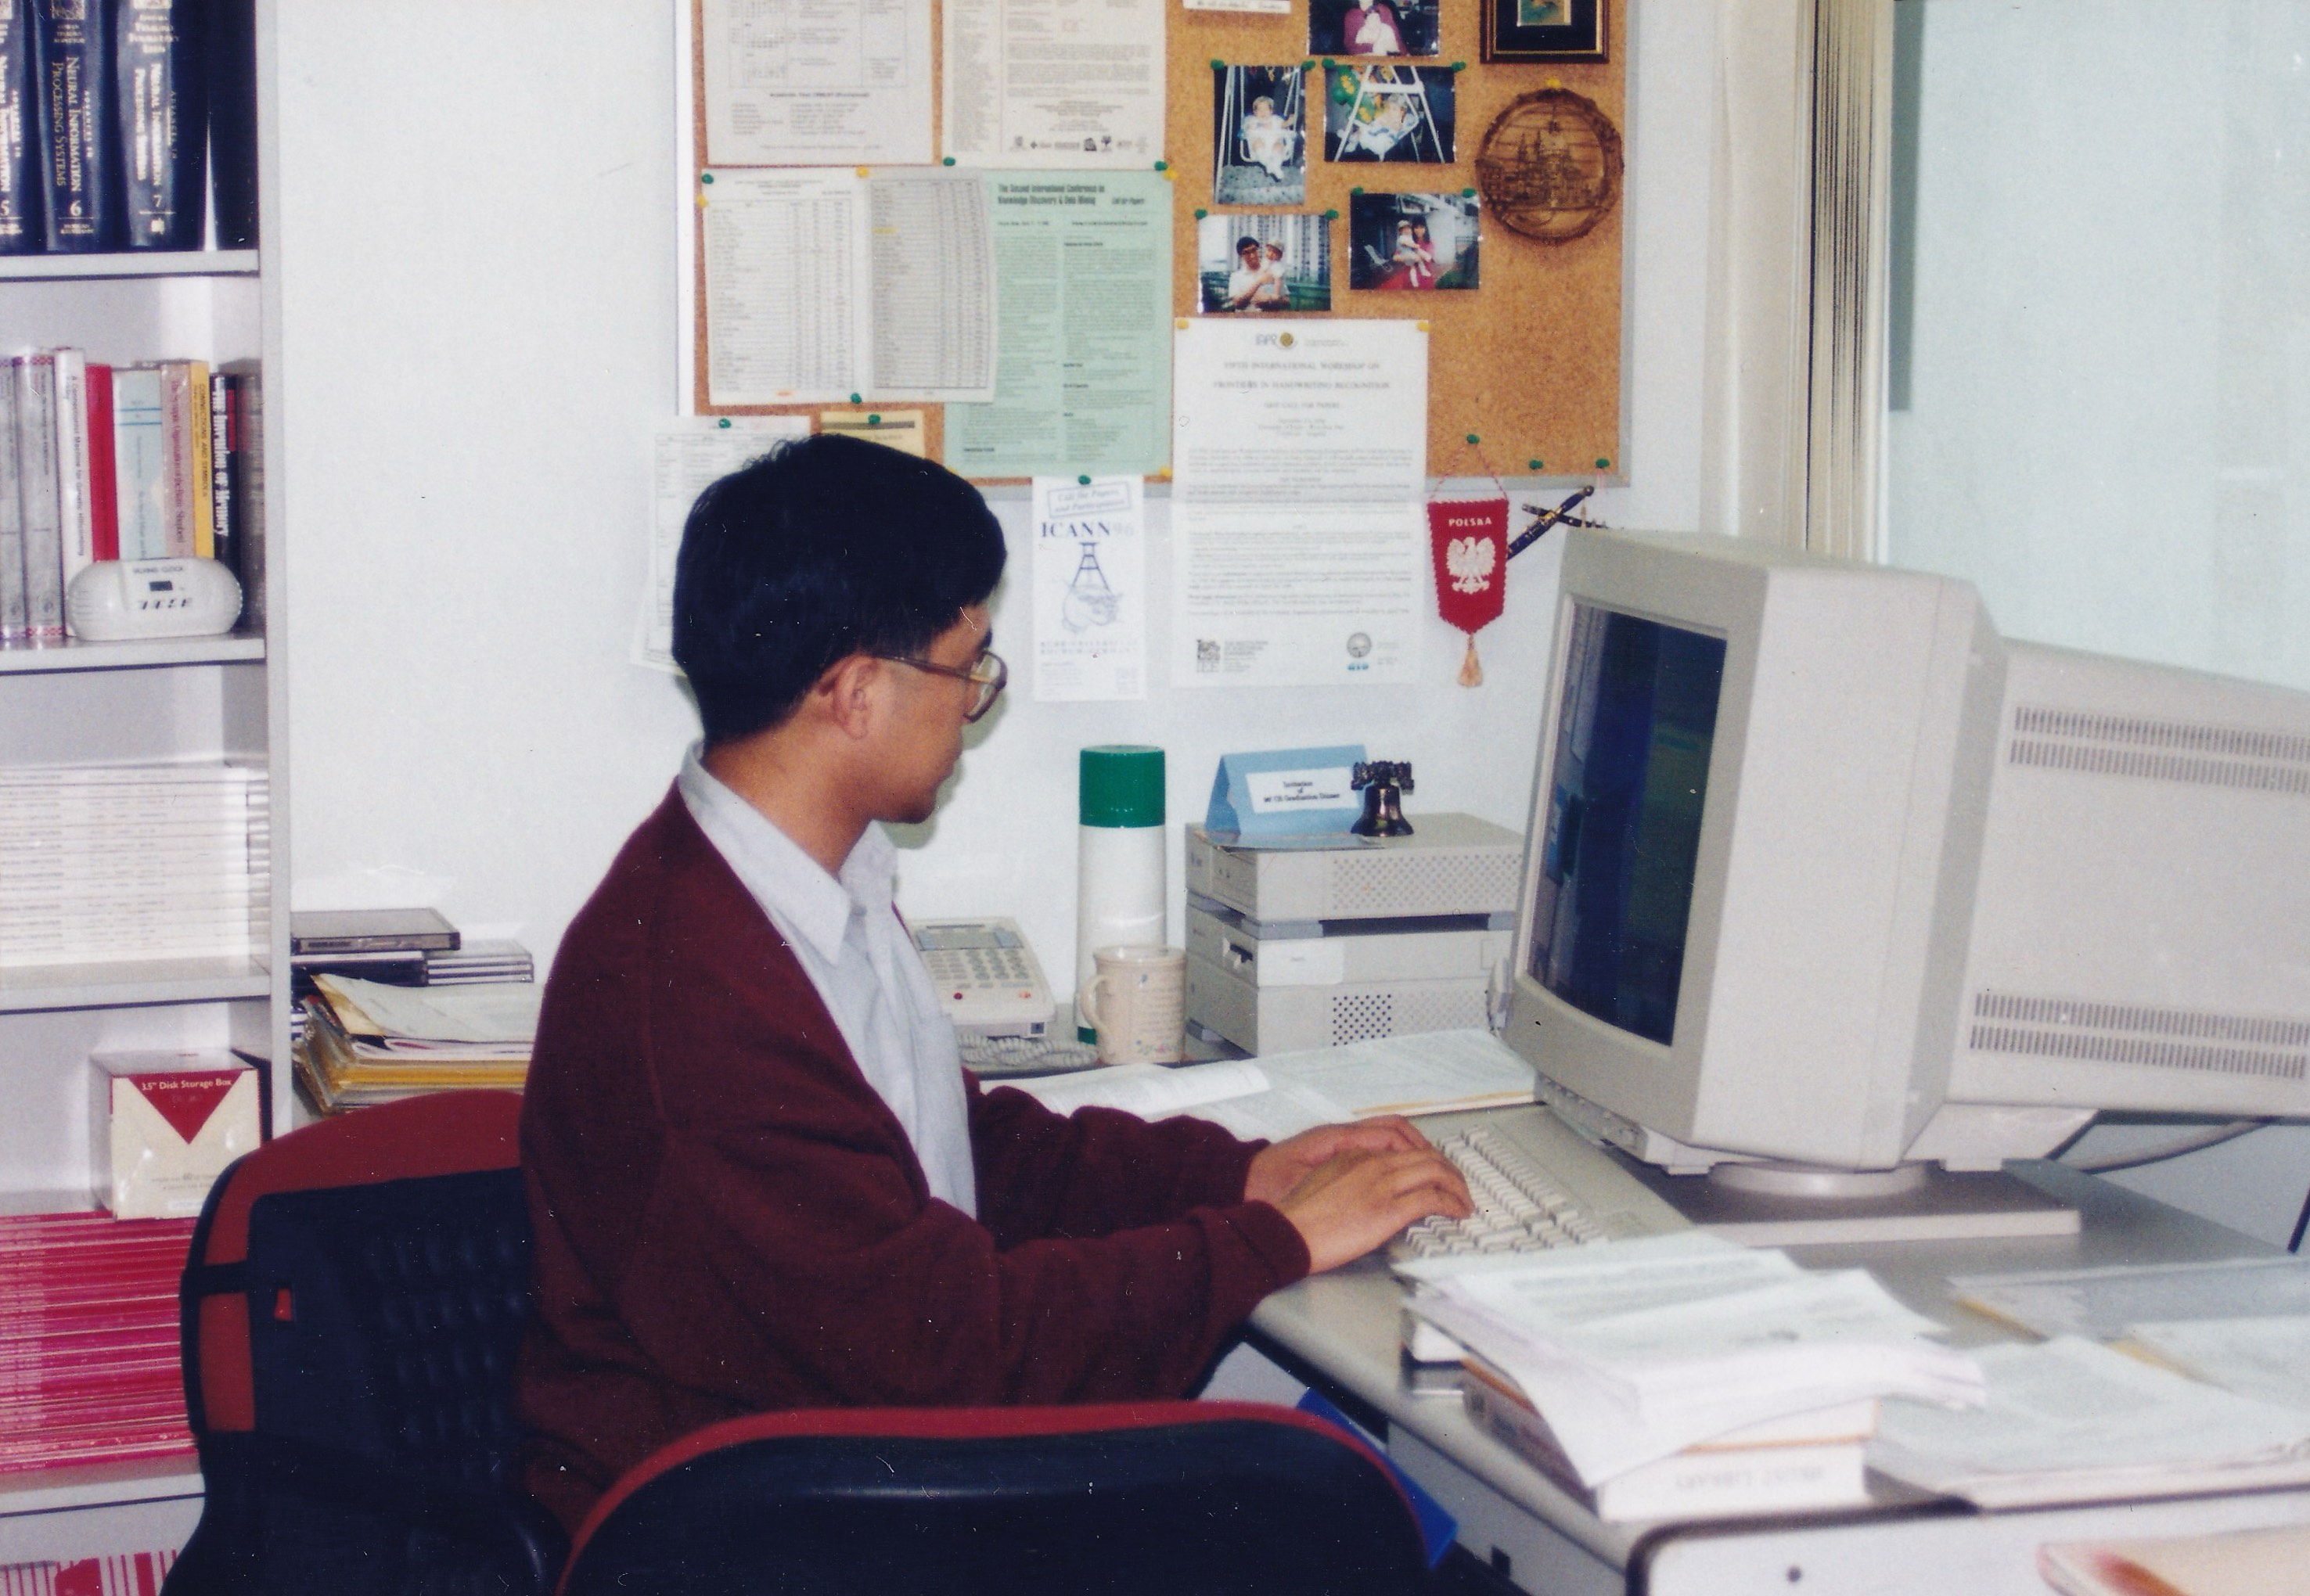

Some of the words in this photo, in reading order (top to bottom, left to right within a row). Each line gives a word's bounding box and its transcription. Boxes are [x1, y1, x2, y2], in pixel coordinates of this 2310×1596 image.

[66, 56, 80, 106] NEURAL
[52, 62, 64, 134] PROCESSING
[68, 109, 82, 192] INFORMATION
[55, 135, 67, 187] SYSTEMS
[0, 200, 10, 216] 5
[70, 200, 82, 217] 6
[153, 194, 162, 208] 7
[1251, 361, 1316, 370] INTERNATIONAL
[1448, 516, 1492, 527] POLSKA
[159, 1080, 178, 1091] Disk
[181, 1080, 214, 1090] Storage
[215, 1078, 232, 1087] Box
